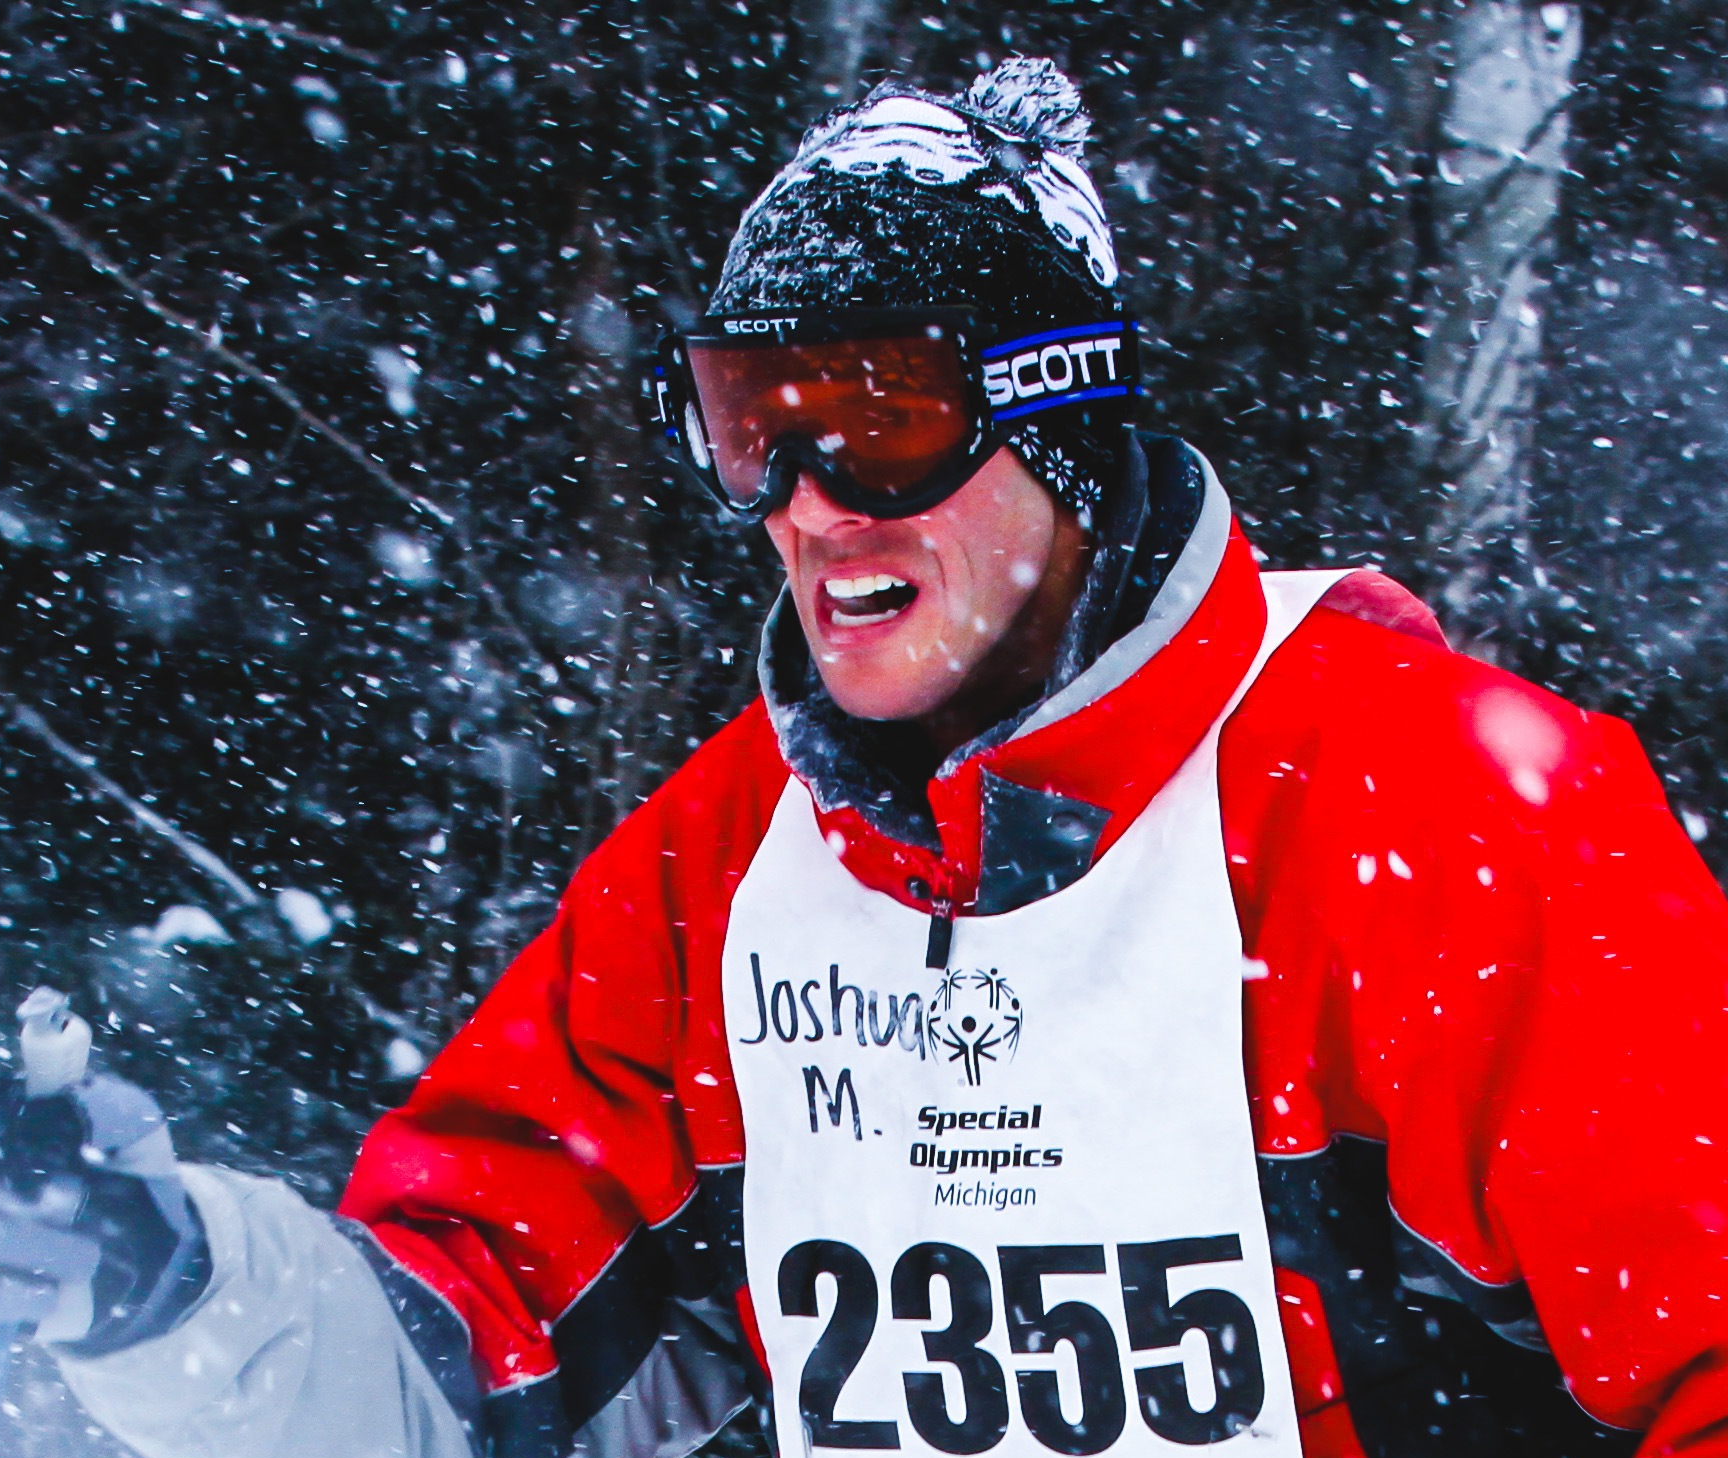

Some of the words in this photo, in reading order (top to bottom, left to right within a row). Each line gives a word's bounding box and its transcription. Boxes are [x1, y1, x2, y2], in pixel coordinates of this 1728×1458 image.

[724, 317, 799, 334] SCOTT
[983, 337, 1121, 406] SCOTT
[738, 952, 927, 1061] Joshua
[802, 1065, 883, 1141] M.
[918, 1104, 1042, 1136] Special
[909, 1142, 1063, 1175] Olympics
[934, 1181, 1037, 1211] Michigan
[777, 1232, 1266, 1457] 2355
